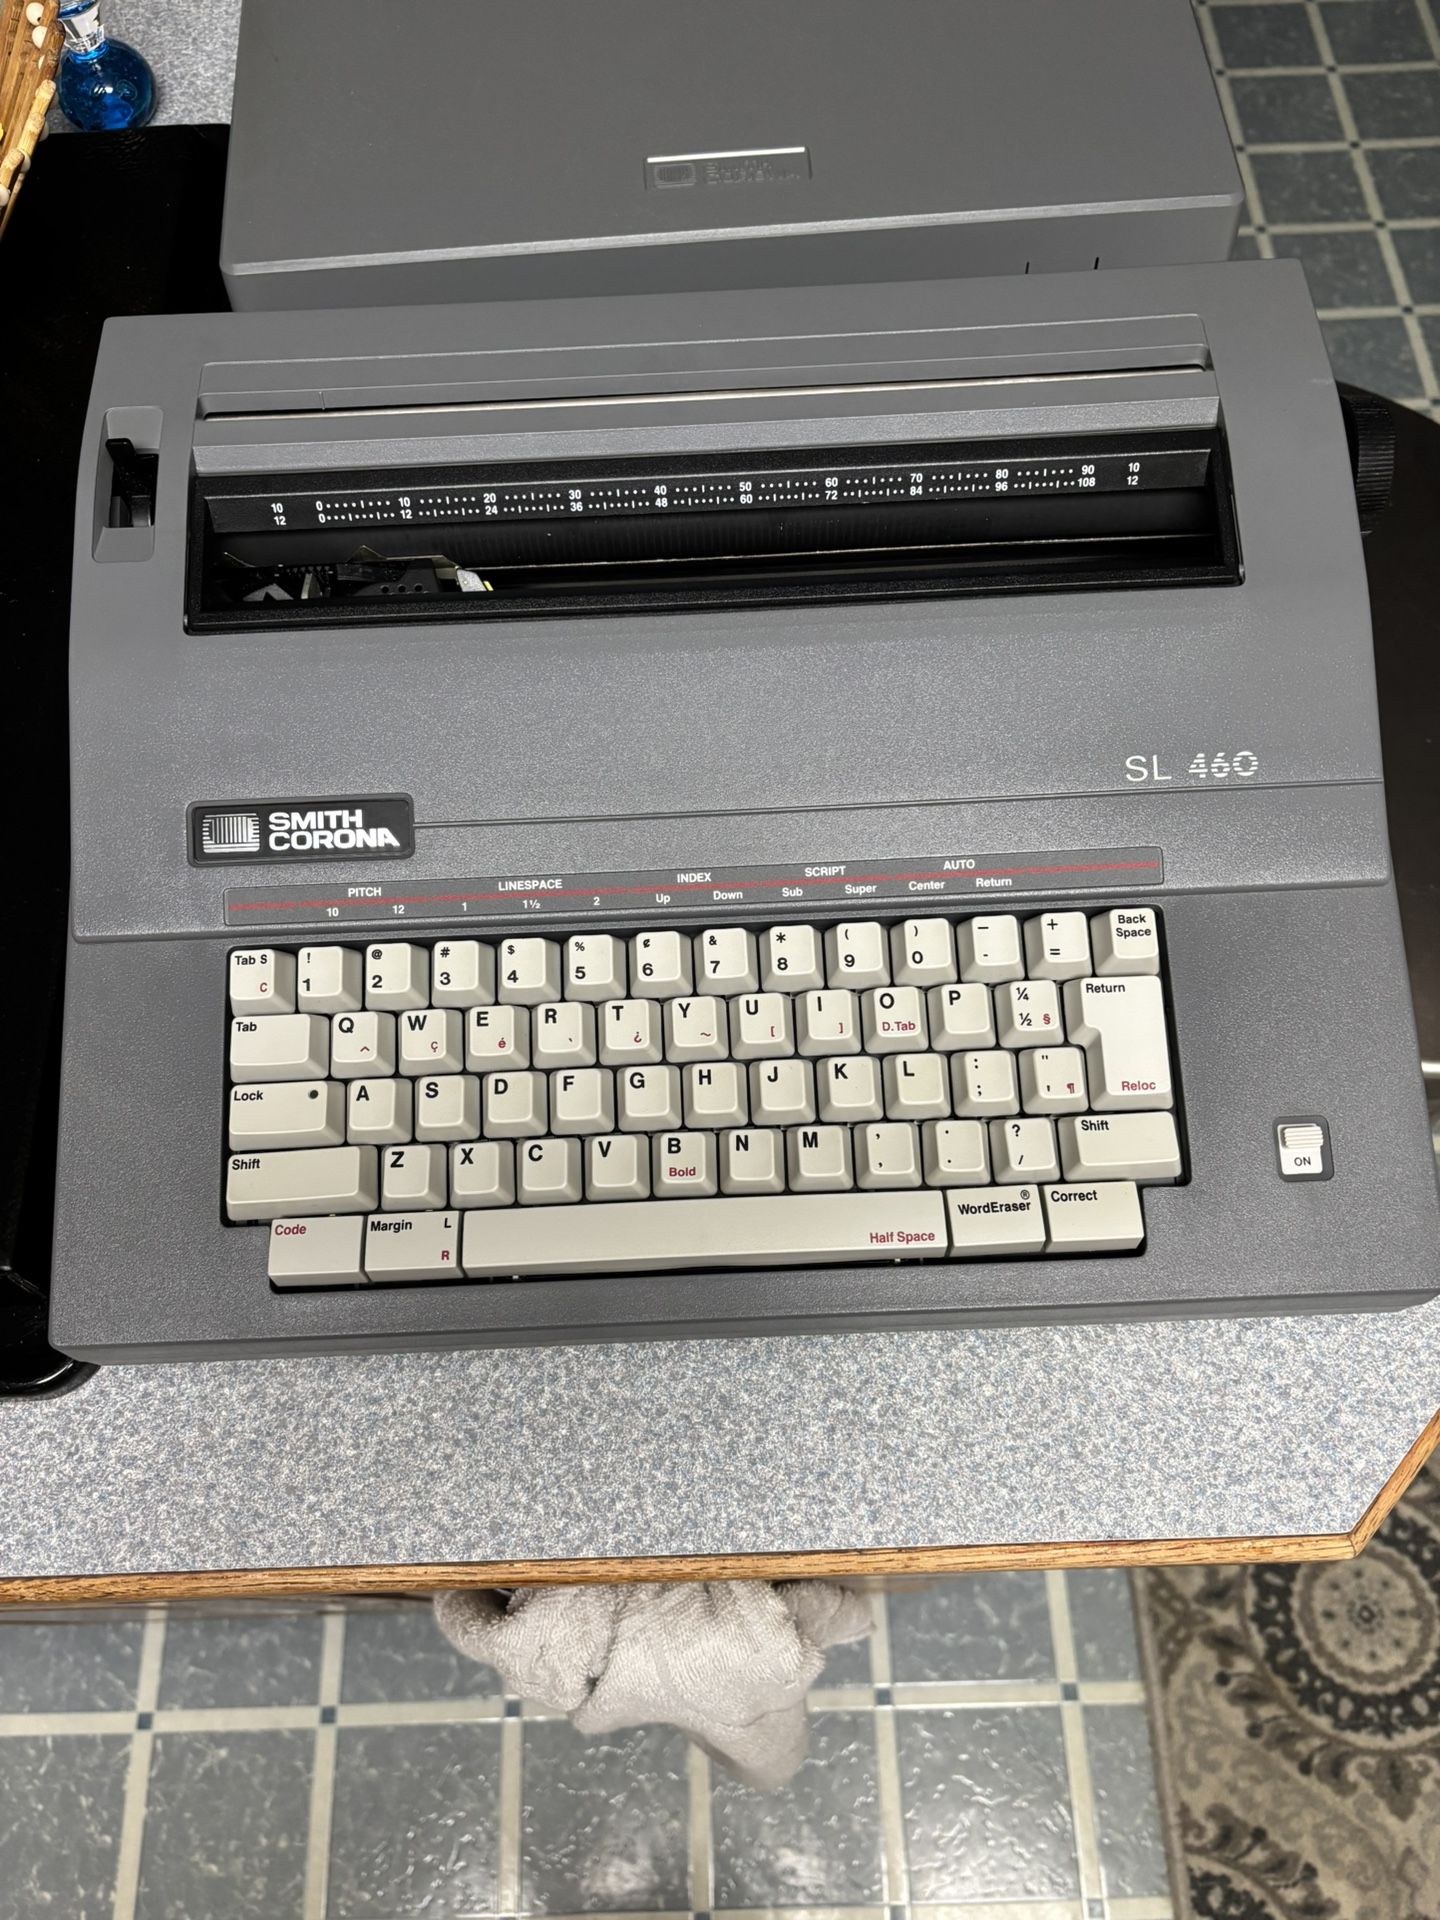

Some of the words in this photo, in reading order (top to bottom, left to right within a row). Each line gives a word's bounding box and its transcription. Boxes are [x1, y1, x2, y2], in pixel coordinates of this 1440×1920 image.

[271, 503, 283, 513] 10
[316, 501, 323, 511] 0
[399, 497, 411, 507] 10
[483, 493, 496, 503] 20
[569, 490, 581, 500] 30
[654, 485, 667, 495] 40
[739, 482, 752, 492] 50
[825, 478, 838, 488] 60
[910, 473, 923, 483] 70
[995, 469, 1009, 479] 80
[1082, 465, 1095, 475] 90
[1128, 462, 1140, 473] 10
[273, 515, 286, 526] 12
[318, 513, 325, 523] 0
[400, 509, 412, 519] 12
[485, 505, 498, 515] 24
[570, 502, 583, 512] 36
[655, 497, 668, 508] 48
[740, 494, 752, 504] 60
[825, 490, 838, 500] 72
[910, 486, 923, 496] 84
[995, 481, 1008, 492] 96
[1077, 477, 1095, 488] 108
[1126, 475, 1139, 485] 12
[1125, 755, 1172, 782] SL
[1188, 751, 1259, 778] 460
[268, 809, 363, 831] SMITH
[268, 827, 400, 851] CORONA
[943, 859, 976, 870] AUTO
[804, 866, 846, 877] SCRIPT
[498, 879, 562, 891] LINESPACE
[677, 873, 712, 884] INDEX
[909, 881, 945, 891] Center
[975, 877, 1012, 887] Return
[348, 887, 382, 898] PITCH
[782, 887, 803, 897] Sub
[845, 884, 877, 895] Super
[462, 902, 468, 911] 1
[593, 897, 600, 906] 2
[655, 893, 671, 905] Up
[713, 890, 743, 900] Down
[326, 907, 339, 917] 10
[392, 905, 405, 914] 12
[1046, 918, 1058, 930] +
[1118, 914, 1147, 924] Back
[844, 928, 849, 940] (
[913, 925, 919, 937] )
[1116, 927, 1152, 939] Space
[574, 941, 585, 951] %
[708, 935, 718, 946] &
[371, 949, 383, 960] @
[440, 947, 450, 958] #
[507, 944, 515, 955] $
[235, 955, 256, 965] Tab
[260, 954, 268, 965] S
[307, 952, 311, 964] !
[844, 954, 855, 967] 9
[912, 950, 923, 964] 0
[642, 963, 654, 976] 6
[710, 960, 720, 974] 7
[777, 957, 788, 971] 8
[440, 972, 451, 985] 3
[507, 970, 519, 983] 4
[575, 966, 586, 980] 5
[259, 982, 267, 993] C
[302, 978, 311, 992] 1
[371, 975, 383, 988] 2
[1086, 983, 1126, 994] Return
[817, 996, 823, 1012] I
[879, 992, 895, 1009] O
[948, 990, 961, 1006] P
[612, 1005, 624, 1021] T
[678, 1002, 691, 1018] Y
[746, 999, 759, 1015] U
[476, 1011, 489, 1027] E
[545, 1008, 557, 1024] R
[1042, 1013, 1051, 1025] §
[236, 1021, 257, 1032] Tab
[338, 1017, 354, 1034] Q
[407, 1015, 427, 1031] W
[882, 1021, 916, 1032] D.Tab
[767, 1066, 778, 1082] J
[834, 1063, 848, 1079] K
[903, 1061, 915, 1077] L
[563, 1075, 575, 1091] F
[629, 1072, 645, 1089] G
[698, 1069, 712, 1085] H
[425, 1081, 439, 1098] S
[494, 1078, 508, 1095] D
[1121, 1080, 1156, 1091] Reloc
[234, 1089, 263, 1101] Lock
[356, 1085, 370, 1101] A
[1012, 1124, 1021, 1137] ?
[1081, 1119, 1110, 1131] Shift
[667, 1137, 682, 1154] B
[735, 1134, 749, 1151] N
[802, 1131, 819, 1148] M
[528, 1144, 543, 1162] C
[598, 1141, 612, 1157] V
[390, 1151, 405, 1168] Z
[460, 1147, 474, 1165] X
[1018, 1154, 1024, 1165] /
[1293, 1156, 1312, 1167] ON
[232, 1158, 260, 1170] Shift
[668, 1166, 696, 1177] Bold
[1050, 1189, 1098, 1202] Correct
[274, 1224, 307, 1235] Code
[370, 1220, 412, 1233] Margin
[444, 1217, 452, 1228] L
[869, 1231, 893, 1243] Half
[897, 1231, 935, 1244] Space
[441, 1250, 450, 1260] R
